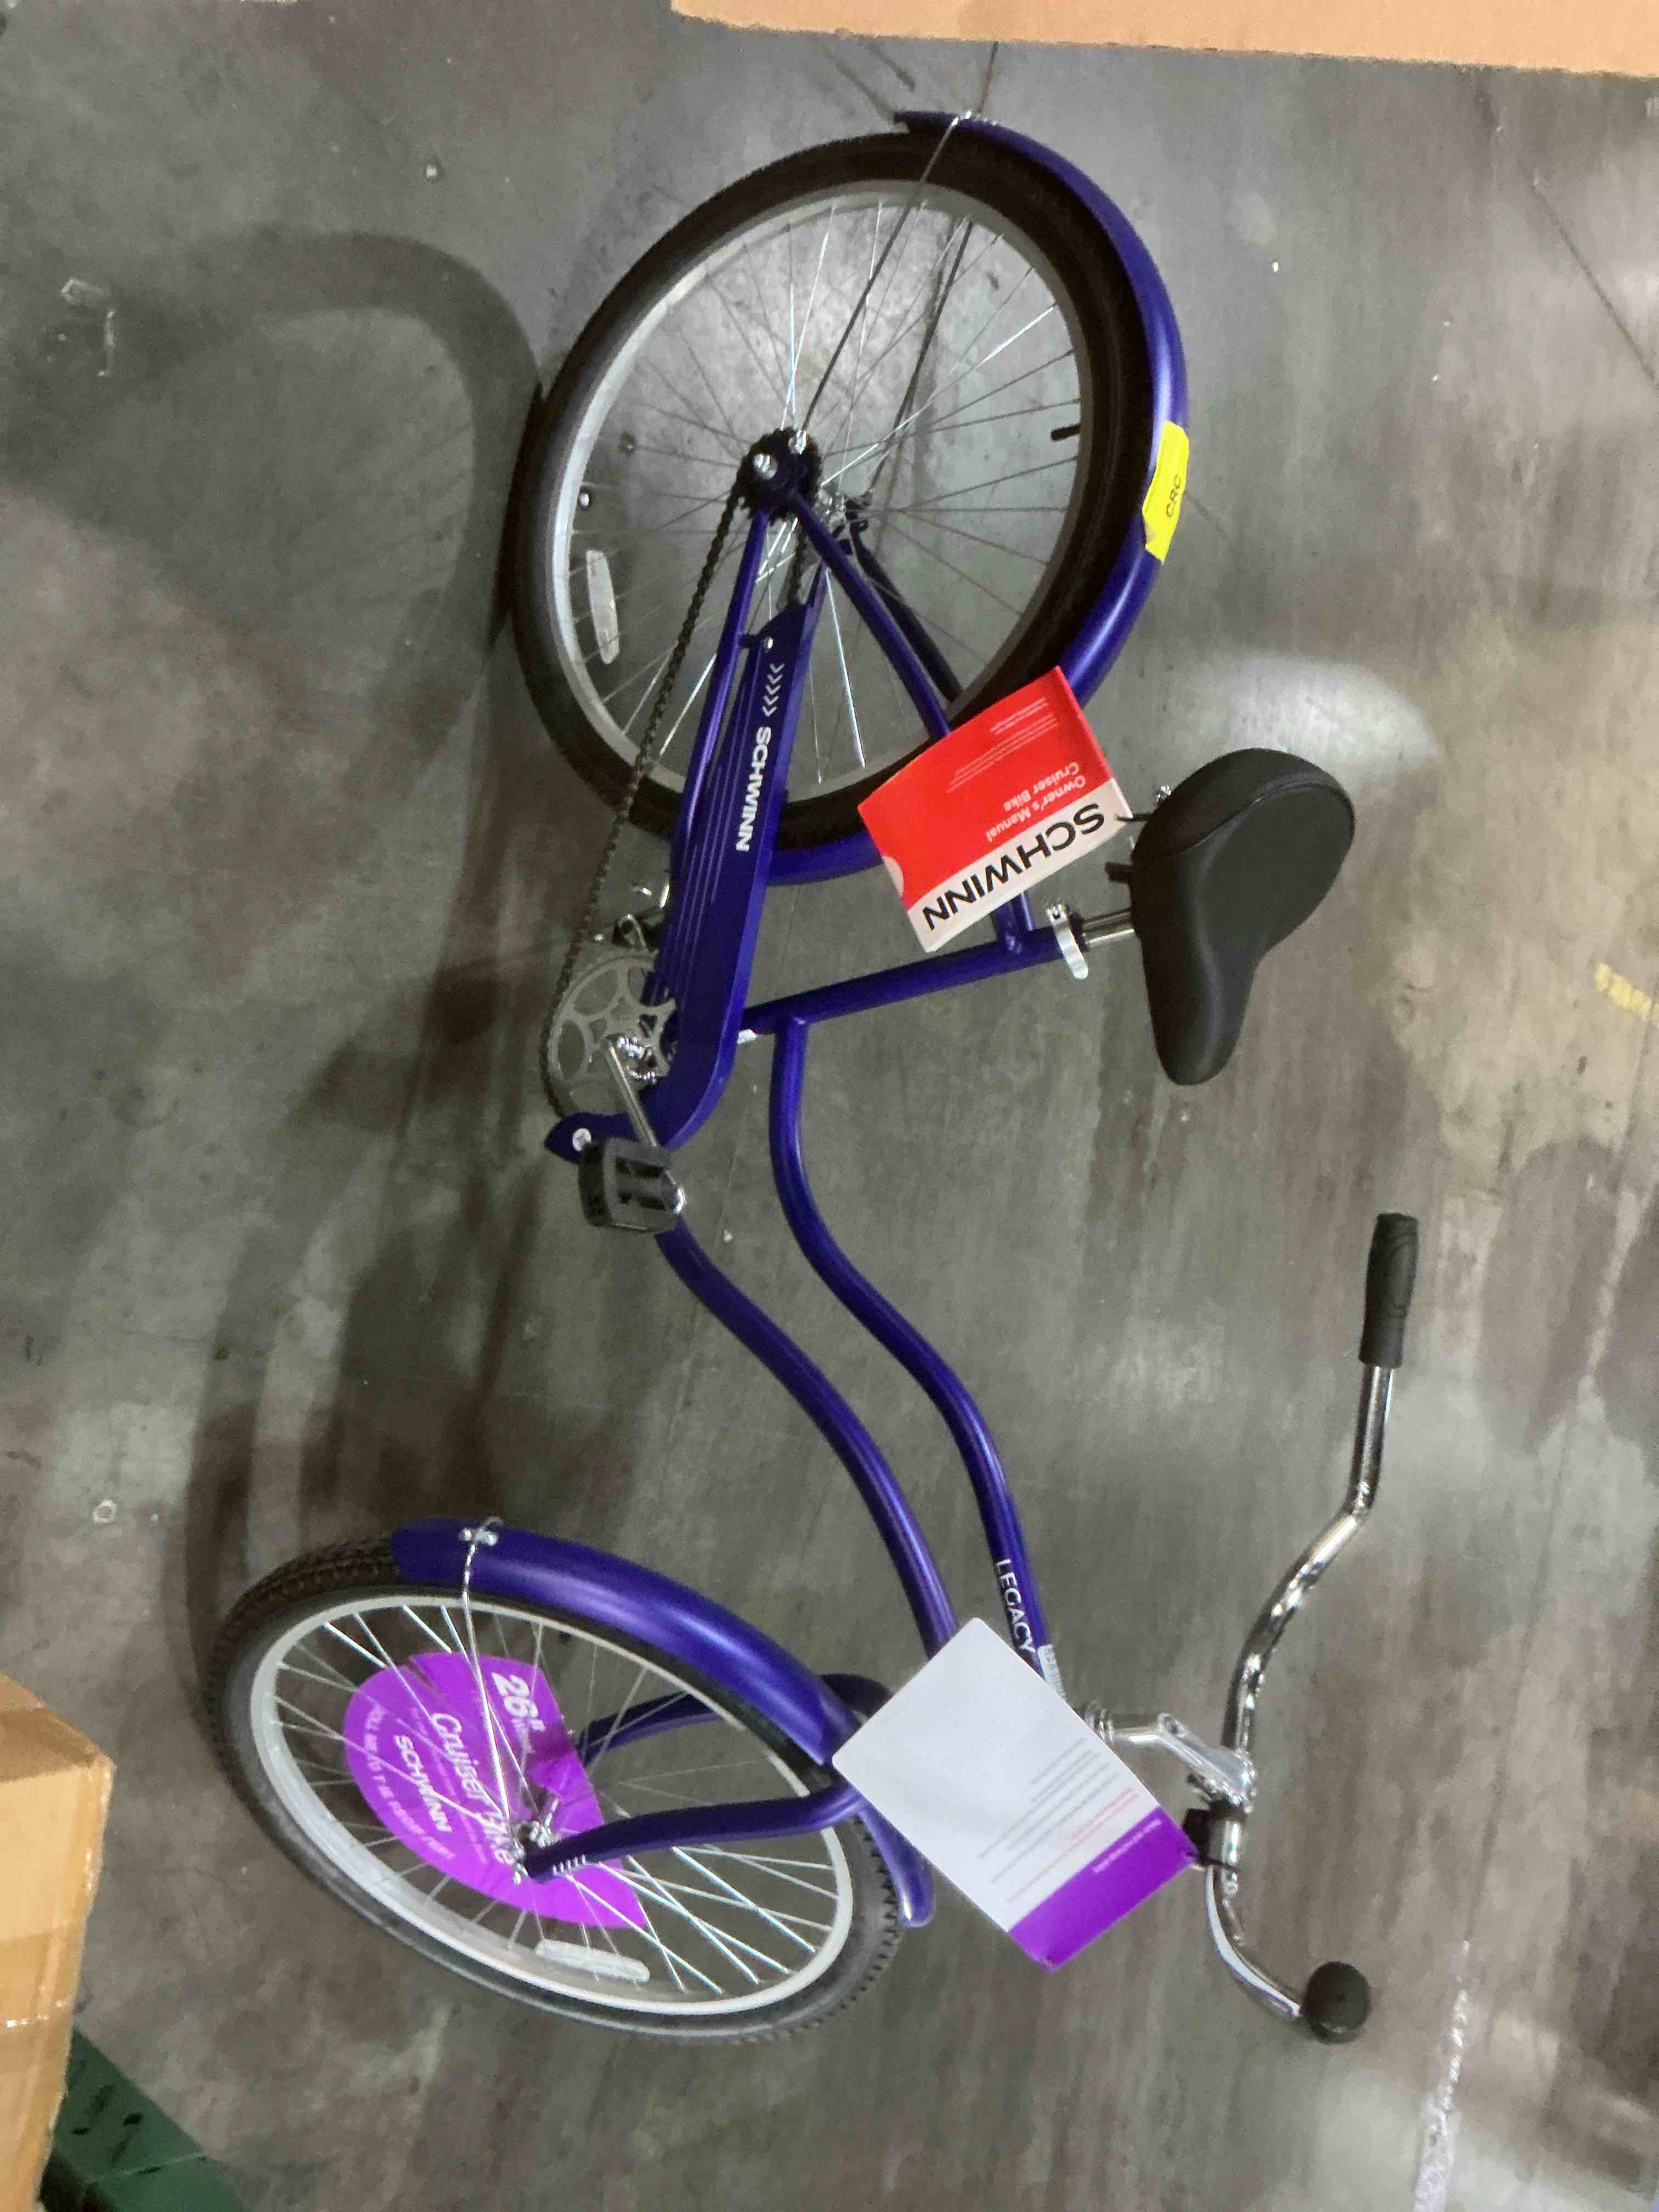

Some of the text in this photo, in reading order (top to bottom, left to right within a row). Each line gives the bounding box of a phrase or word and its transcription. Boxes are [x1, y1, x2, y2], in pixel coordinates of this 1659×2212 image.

[736, 726, 772, 852] SCHWINN
[986, 775, 1086, 843] Owner's Manual
[1003, 761, 1080, 812] Cruiser Bike
[922, 803, 1105, 930] SCHWINN
[996, 1559, 1036, 1653] LEGACY
[394, 1734, 452, 1832] SCHWINN
[432, 1713, 487, 1802] Cruiser
